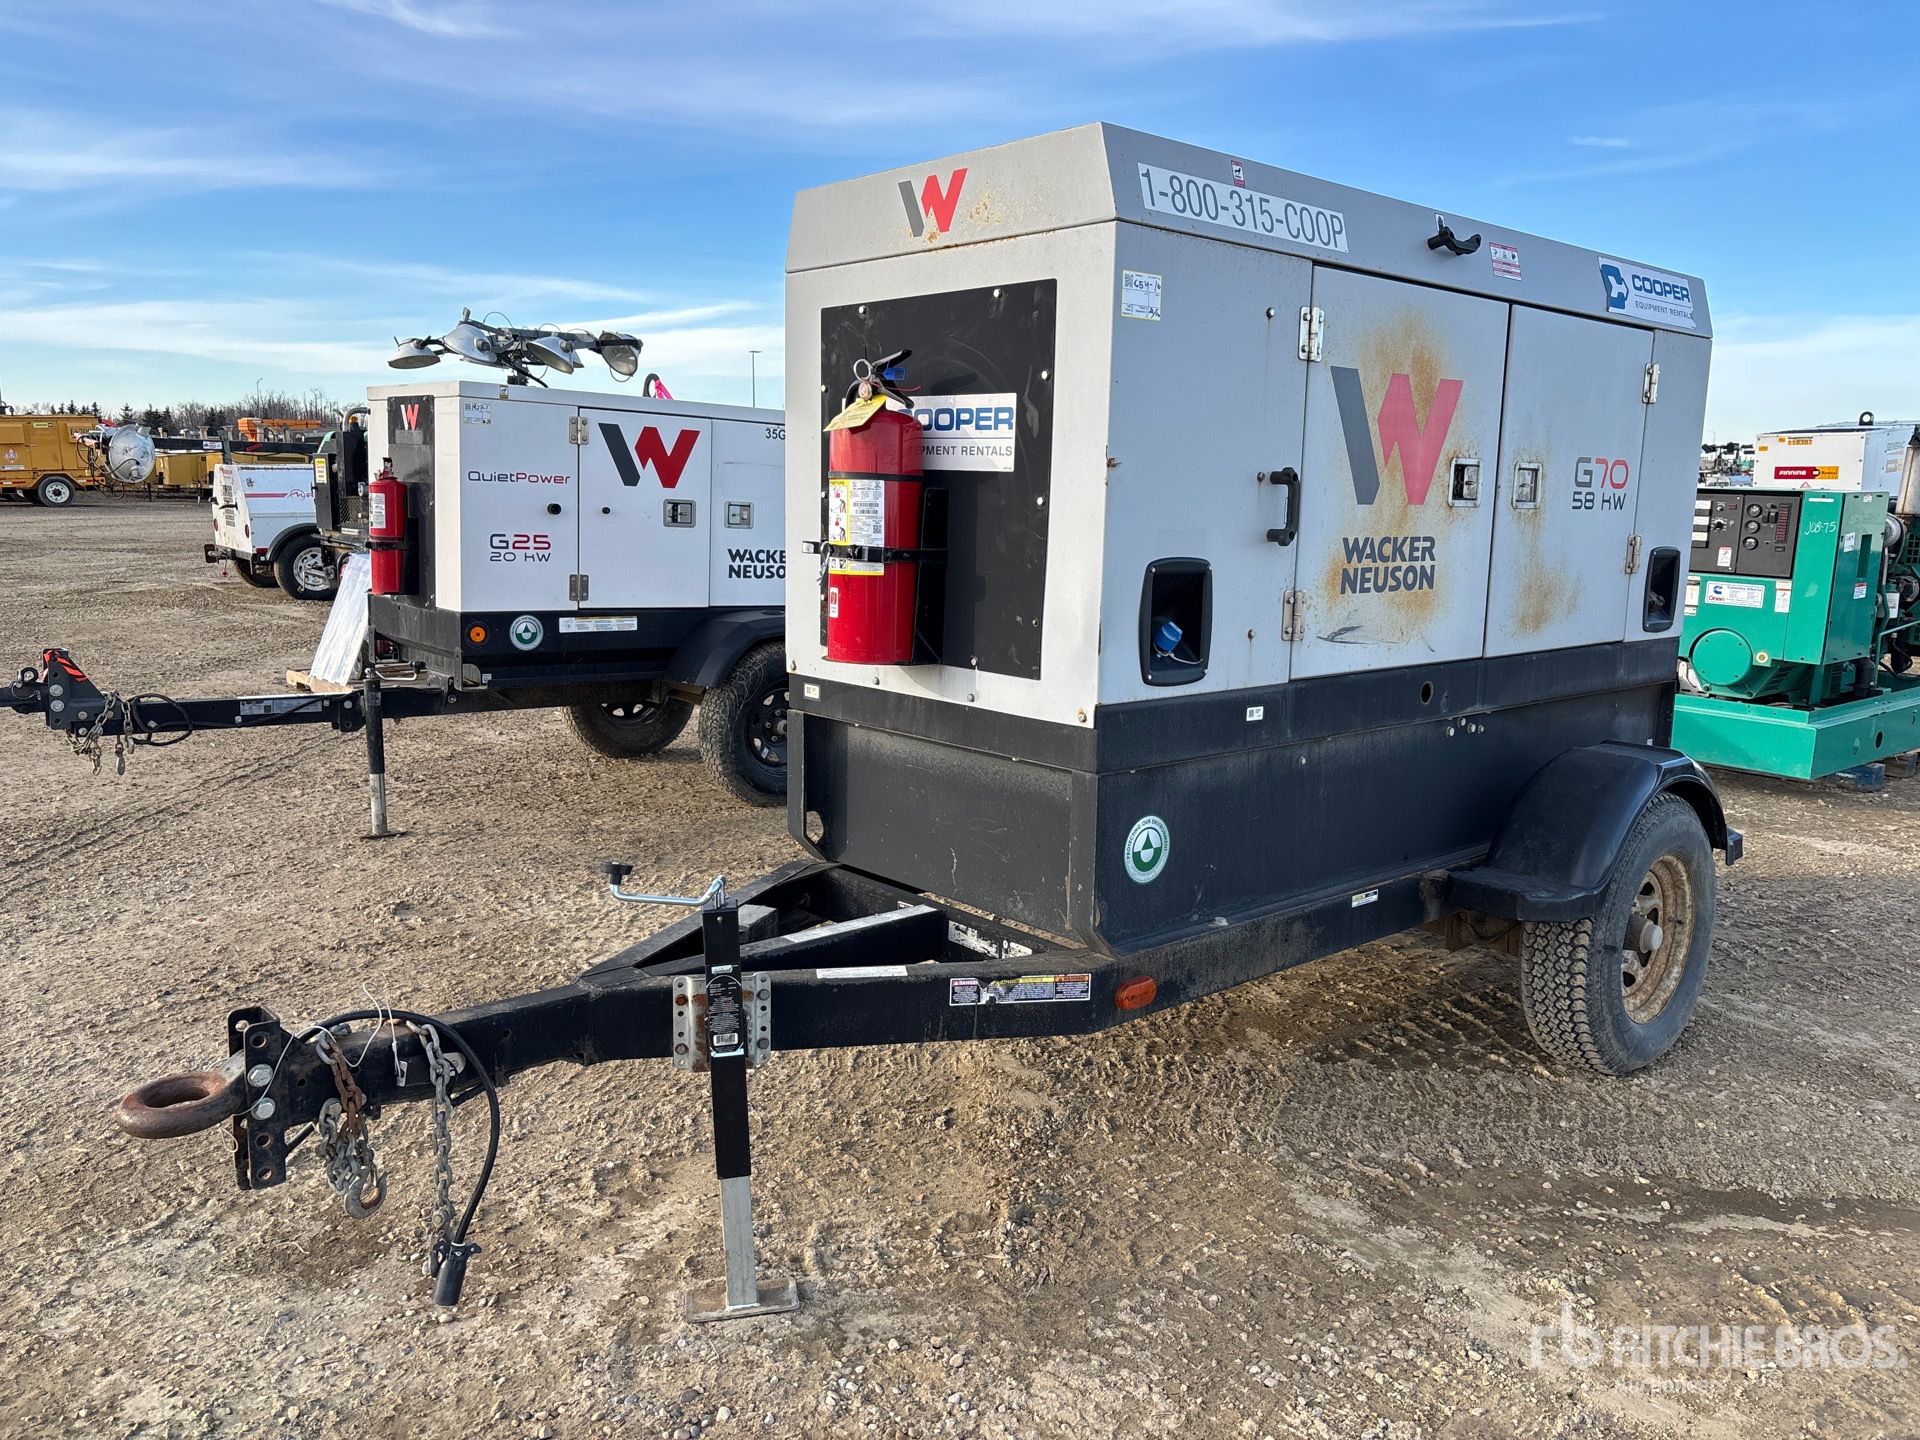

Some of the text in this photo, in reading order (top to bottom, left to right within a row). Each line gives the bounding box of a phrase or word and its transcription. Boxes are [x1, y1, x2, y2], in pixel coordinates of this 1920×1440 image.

[1141, 168, 1344, 249] 1-800-315-COOP
[1632, 273, 1691, 303] COOPER
[1635, 300, 1694, 320] EQUIPMENT RENTALS
[960, 445, 1013, 457] RENTALS
[467, 470, 571, 485] QuietPower
[1574, 456, 1630, 490] G70
[1571, 490, 1596, 511] 58
[489, 533, 552, 551] G25
[1341, 535, 1436, 565] WACKER
[489, 551, 517, 562] 20
[727, 548, 786, 564] WACKE
[728, 564, 786, 580] NEUSO
[1340, 564, 1436, 595] NEUSON
